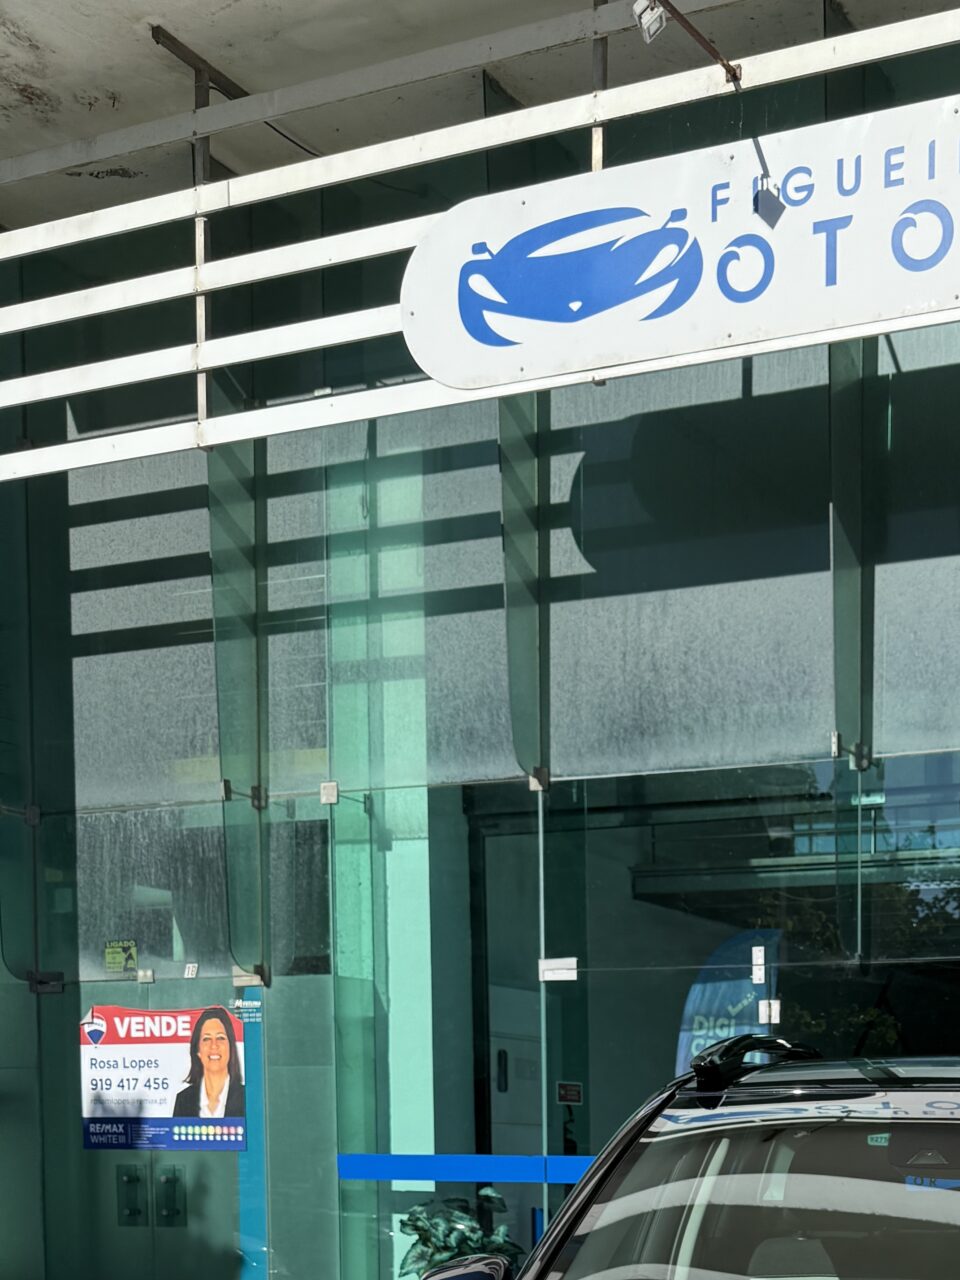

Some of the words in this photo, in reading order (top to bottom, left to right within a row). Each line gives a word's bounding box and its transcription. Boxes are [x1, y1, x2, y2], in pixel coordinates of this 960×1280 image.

[113, 1015, 192, 1038] VENDE
[692, 1015, 736, 1037] DIGI
[90, 1057, 119, 1069] Rosa
[123, 1057, 159, 1071] Lopes
[90, 1078, 112, 1091] 919
[117, 1078, 139, 1091] 417
[144, 1077, 169, 1090] 456
[89, 1123, 125, 1134] RE/MAX
